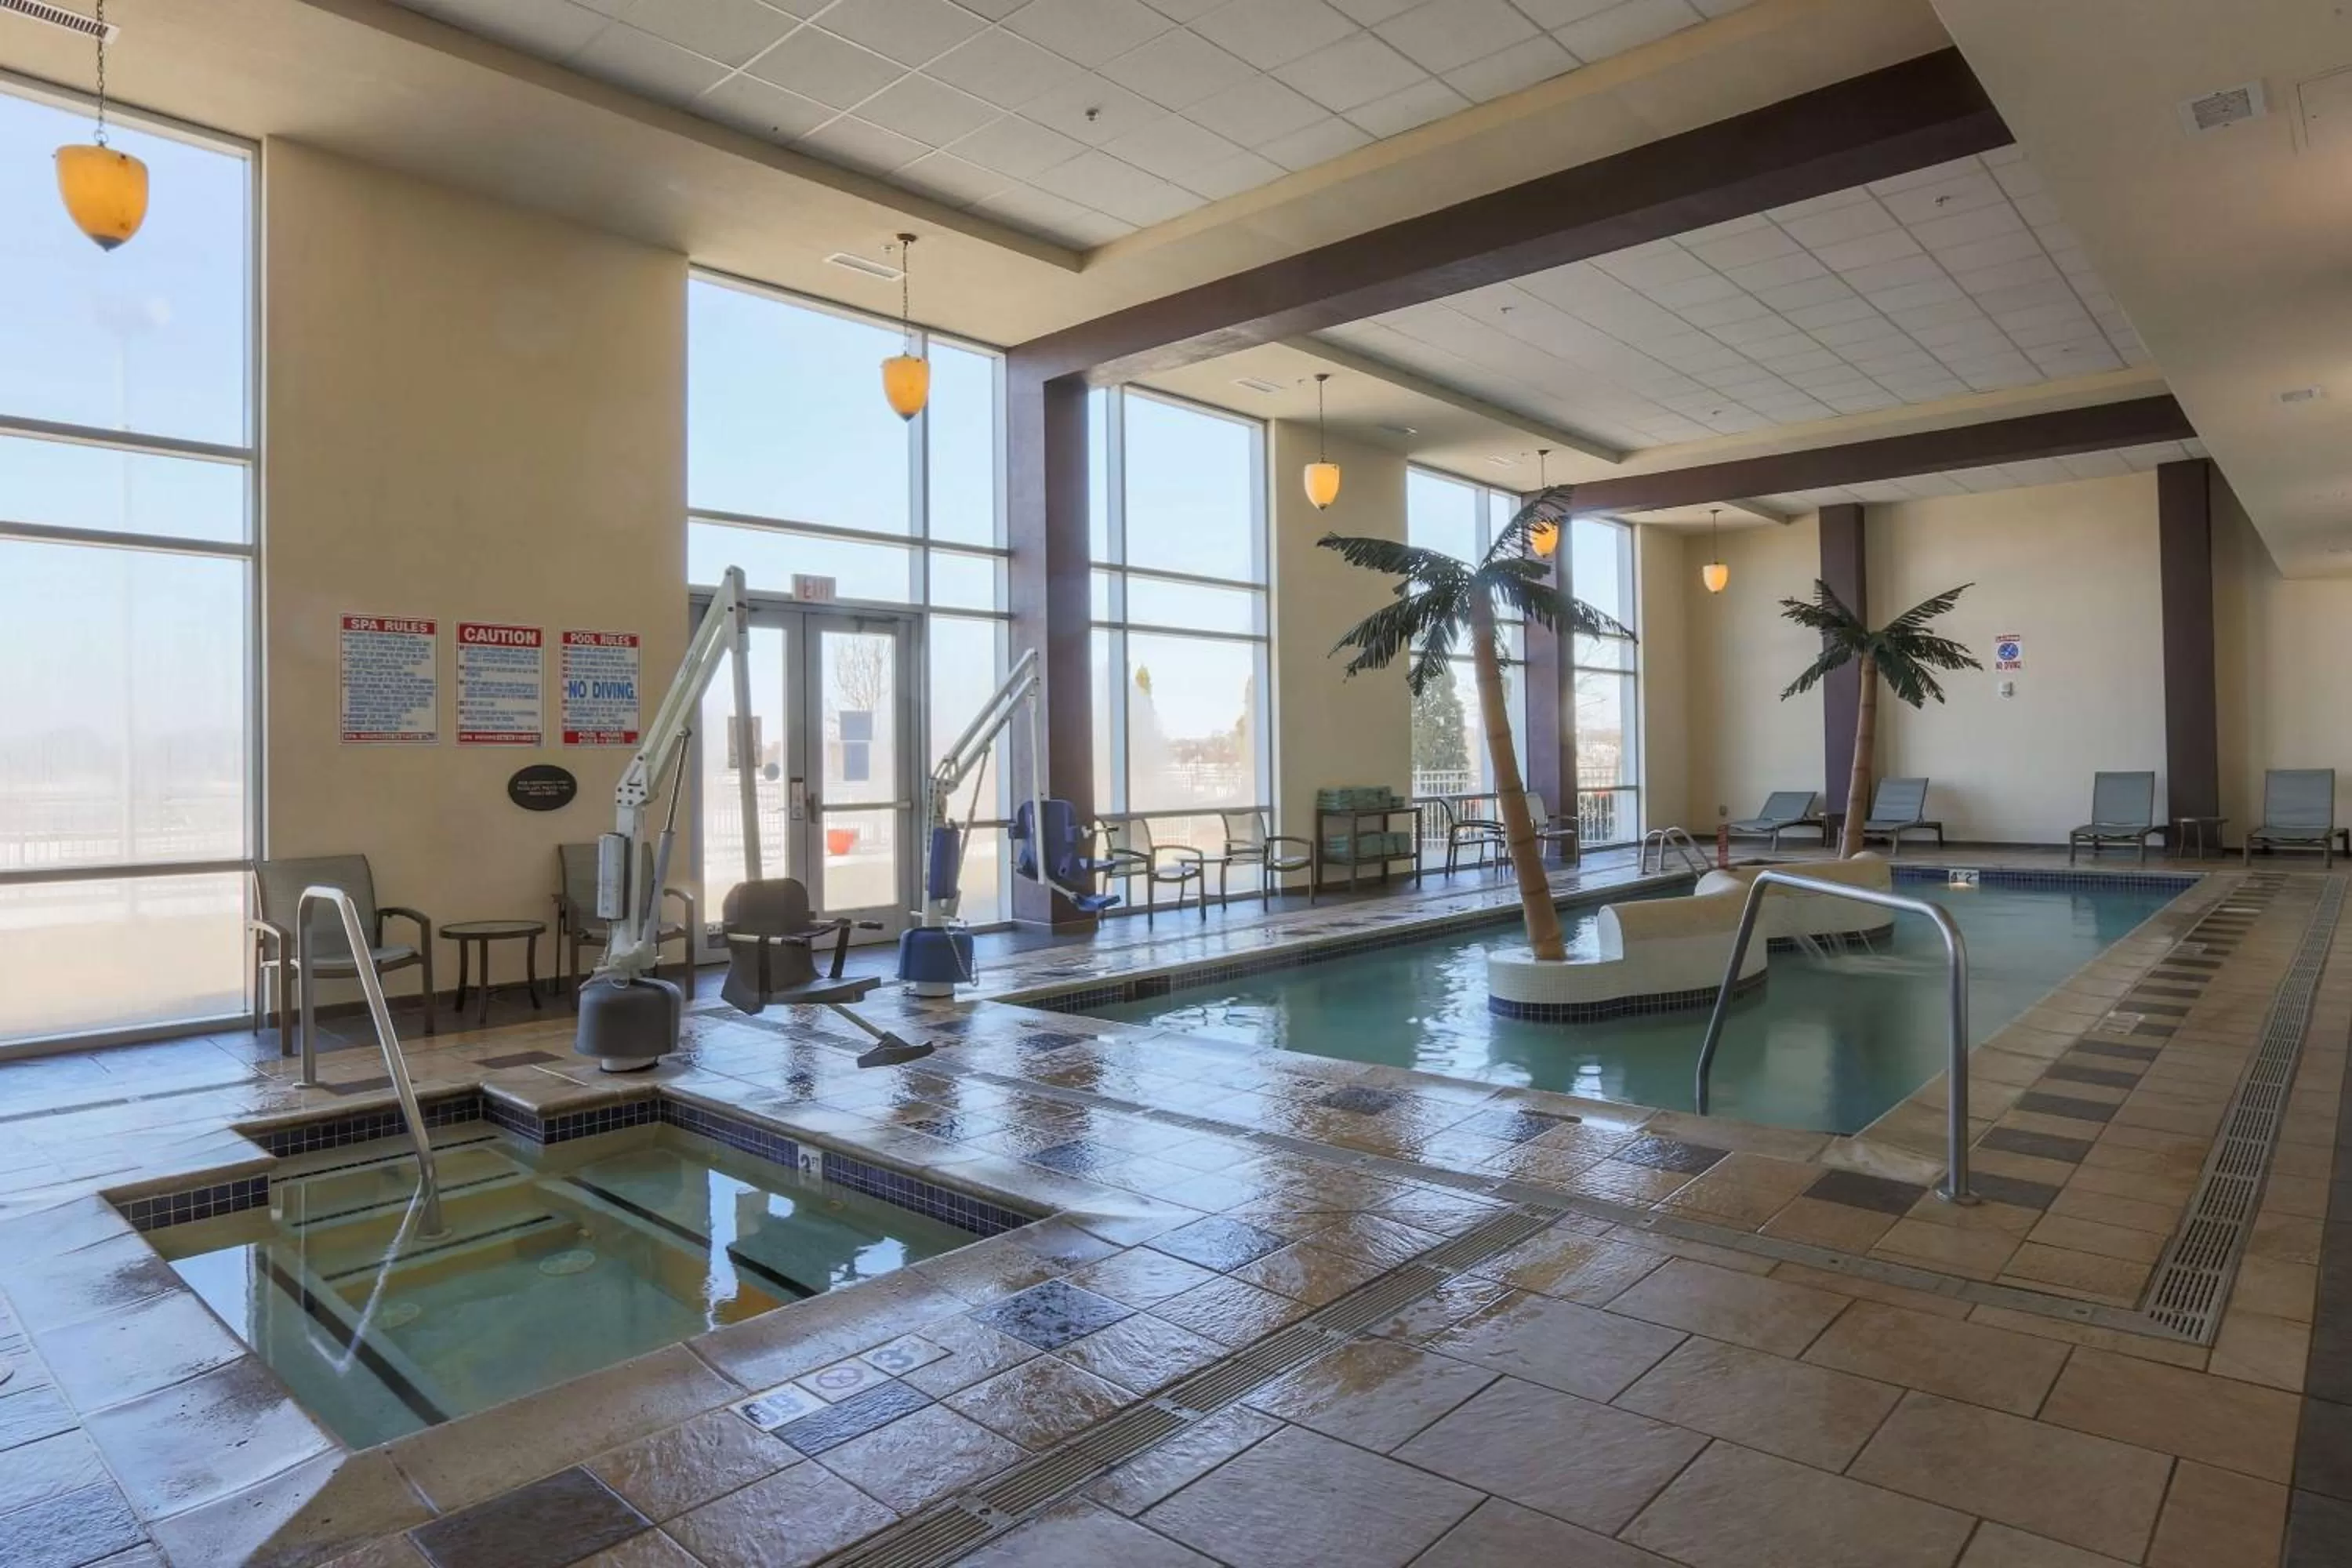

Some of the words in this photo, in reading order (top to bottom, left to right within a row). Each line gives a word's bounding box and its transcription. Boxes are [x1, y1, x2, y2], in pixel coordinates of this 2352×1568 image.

[351, 619, 378, 630] SPA
[384, 621, 428, 633] RULES
[463, 627, 537, 645] CAUTION
[570, 633, 596, 644] POOL
[601, 634, 630, 646] RULES
[568, 680, 587, 699] NO
